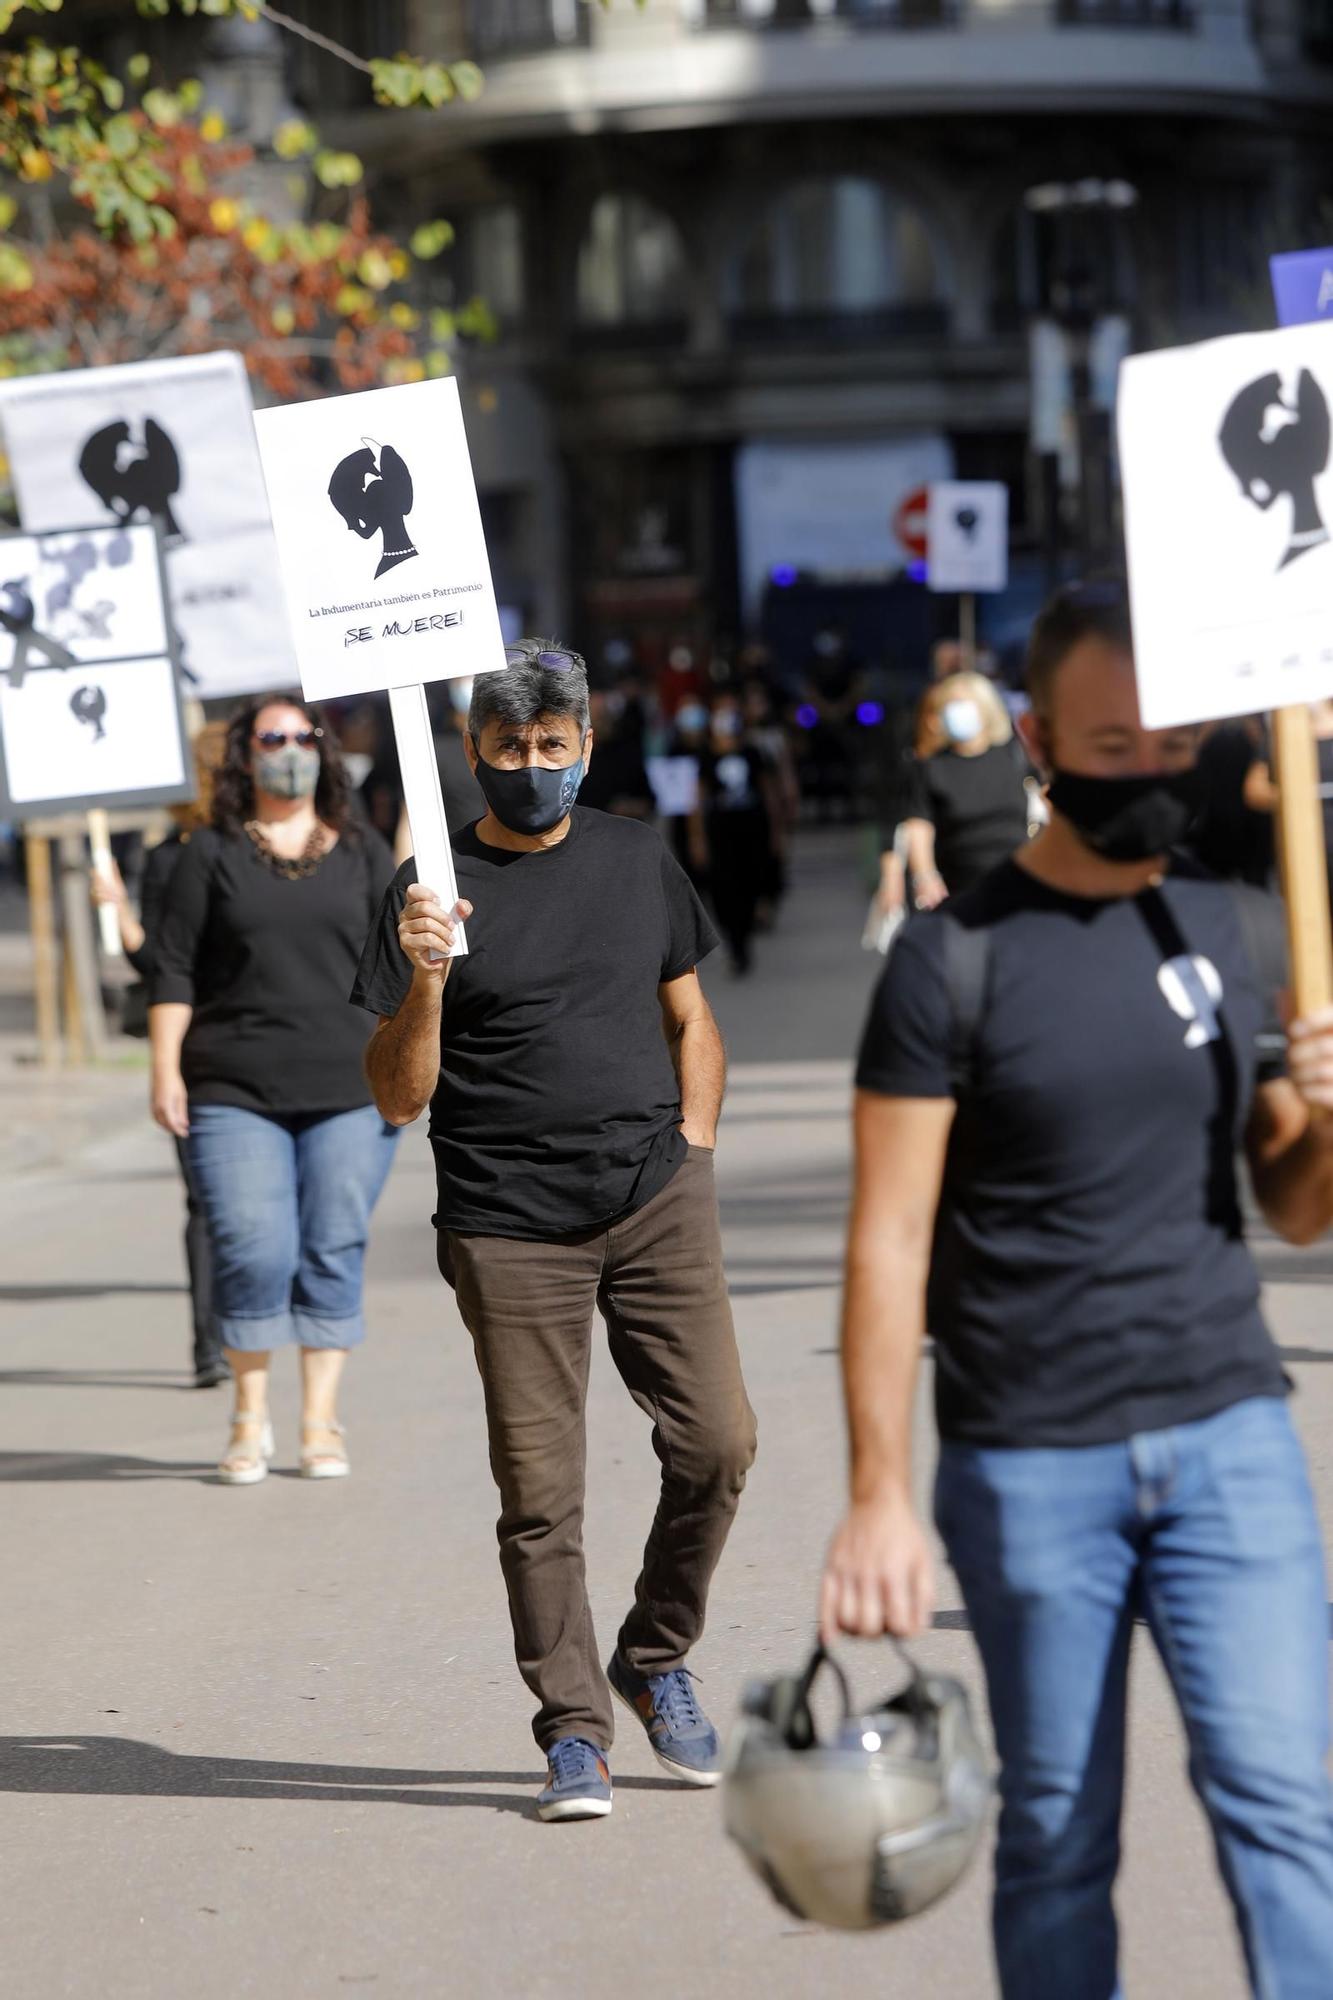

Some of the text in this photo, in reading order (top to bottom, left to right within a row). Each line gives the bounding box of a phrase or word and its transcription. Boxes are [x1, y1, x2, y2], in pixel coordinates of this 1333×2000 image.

[309, 608, 321, 618] La
[321, 600, 382, 617] Indumentaria
[421, 591, 432, 599] es
[432, 582, 483, 598] Patrimonio
[344, 609, 464, 648] ¡SE MUERE!
